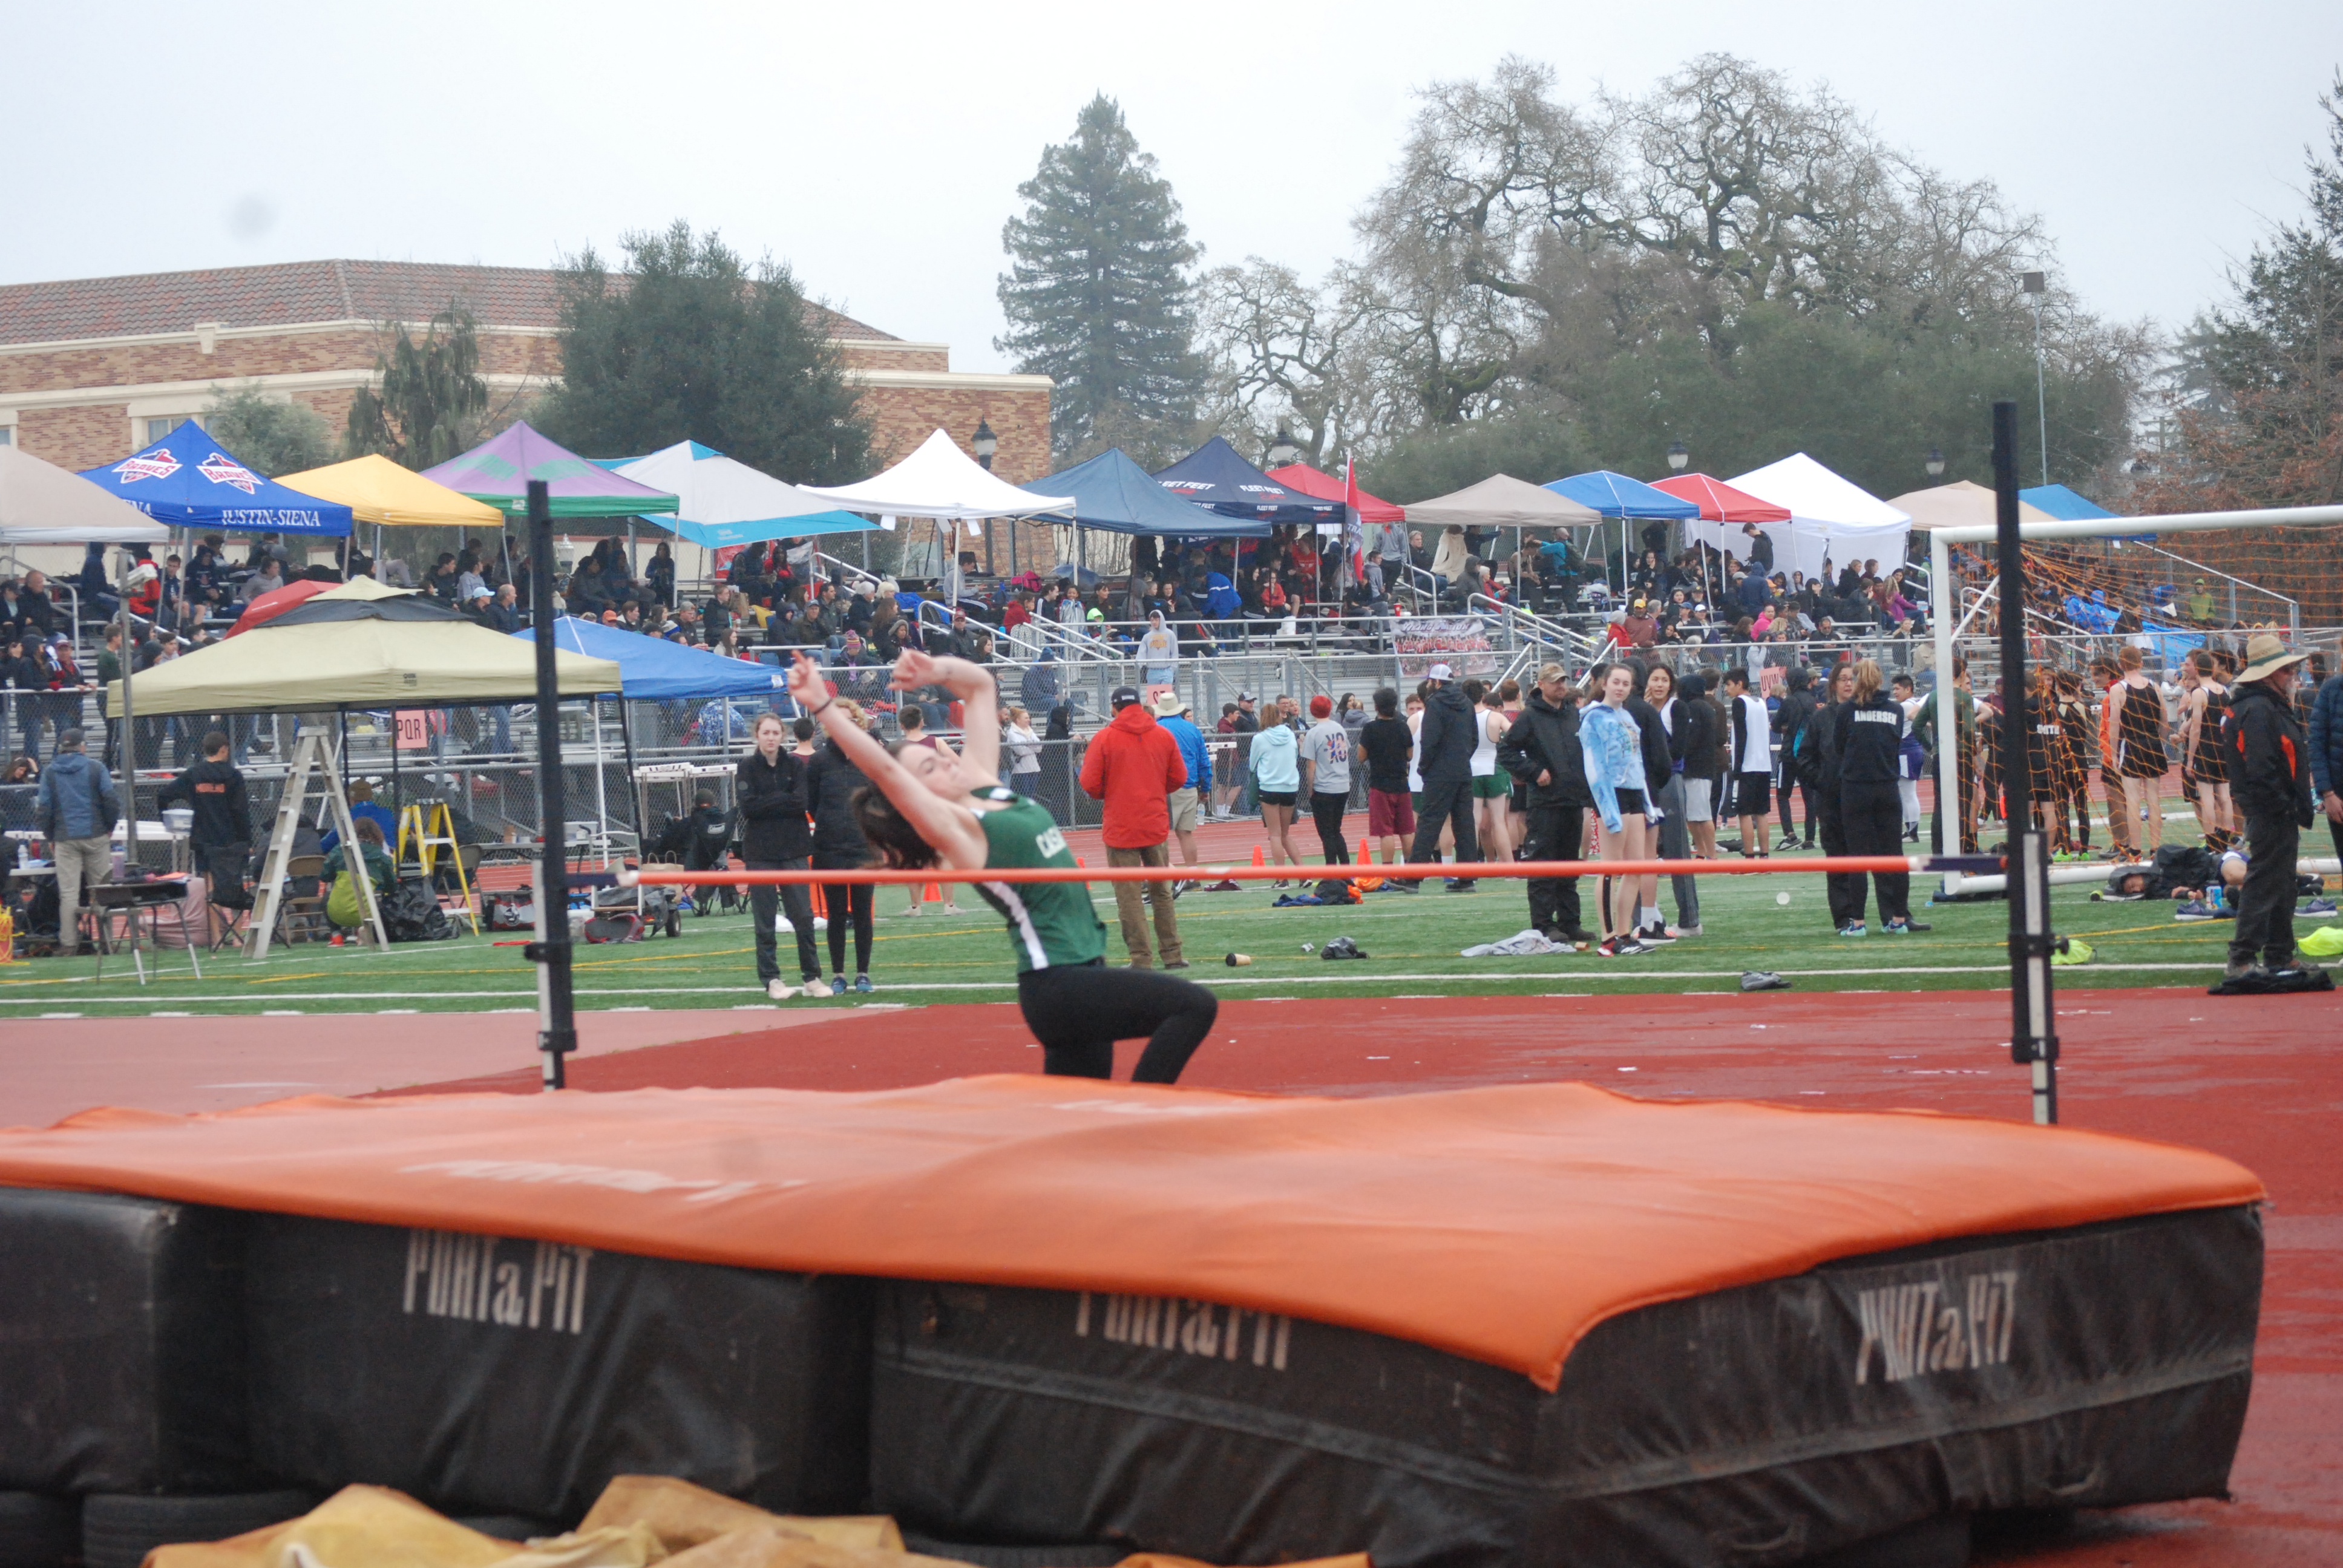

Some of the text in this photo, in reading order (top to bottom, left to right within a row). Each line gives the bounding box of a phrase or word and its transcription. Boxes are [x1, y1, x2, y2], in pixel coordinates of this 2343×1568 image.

[119, 460, 176, 476] BRAVES
[203, 468, 257, 482] BRAVES
[1183, 482, 1216, 490] FEET
[221, 509, 321, 526] JUSTIN-SIENA
[1761, 673, 1779, 691] UVW
[1854, 710, 1897, 725] ANDERSEN
[396, 719, 421, 740] PQR
